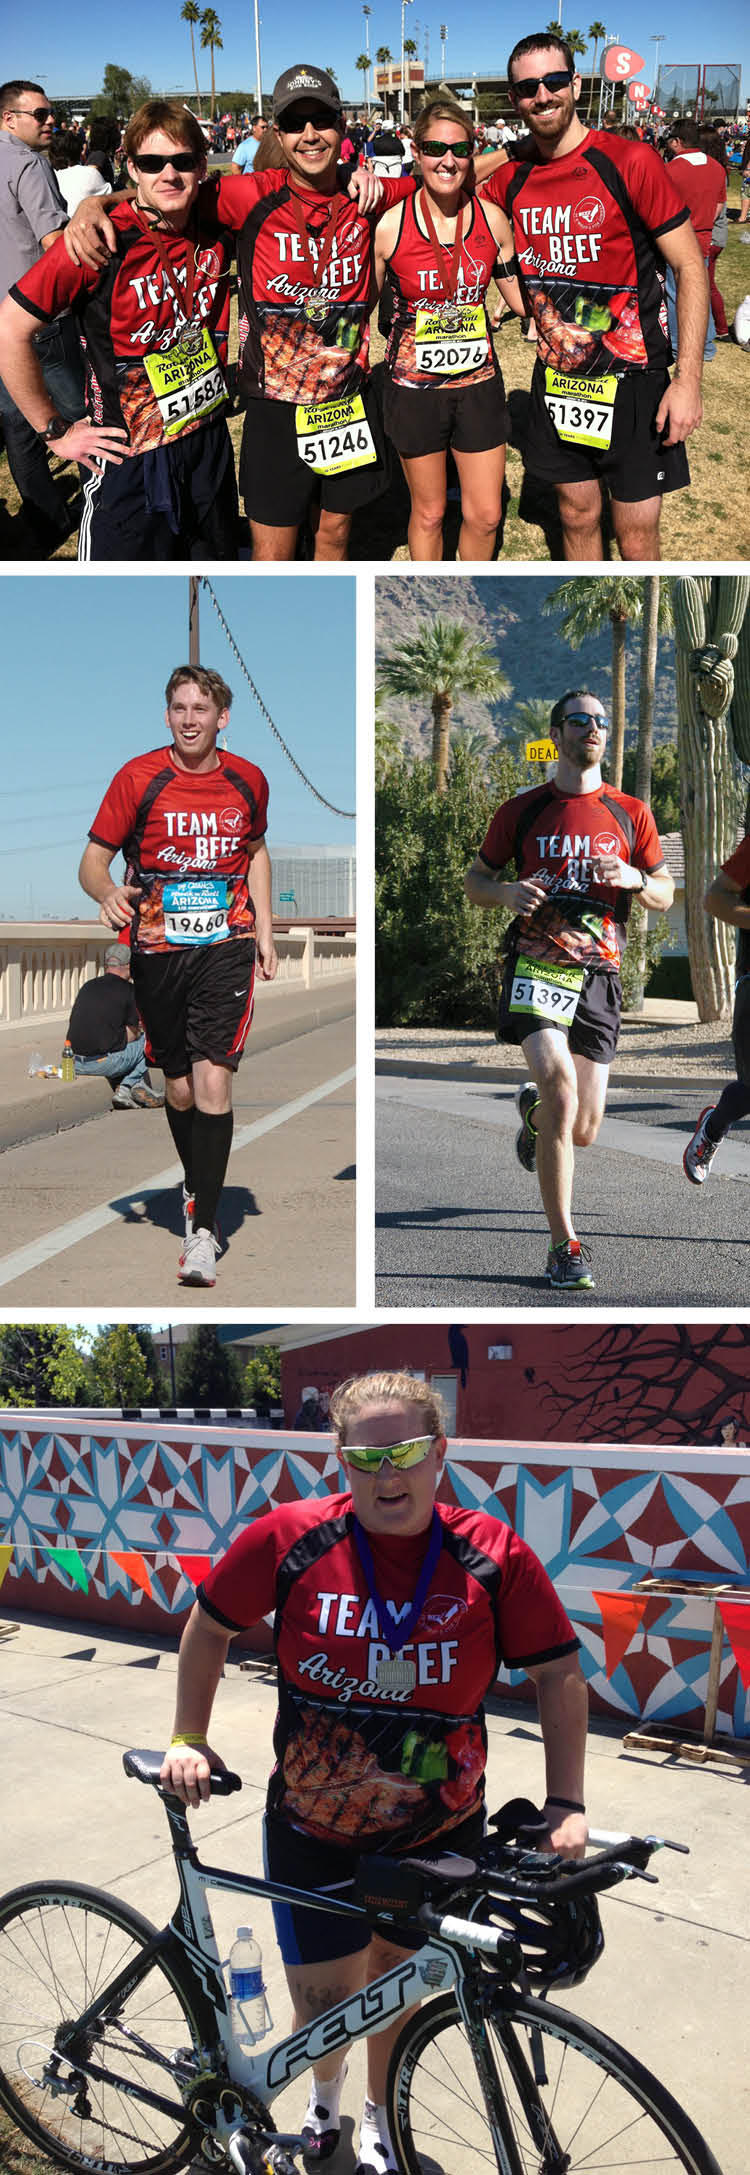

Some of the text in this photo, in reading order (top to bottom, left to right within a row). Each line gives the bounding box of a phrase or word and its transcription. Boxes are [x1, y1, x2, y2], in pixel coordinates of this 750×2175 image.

[616, 52, 631, 74] S
[634, 85, 645, 98] N
[520, 205, 571, 235] TEAM
[549, 234, 601, 264] BEEF
[518, 246, 577, 278] Arizona
[266, 273, 341, 305] Arizona
[421, 346, 483, 369] 52076
[167, 372, 224, 418] 51582
[552, 377, 604, 395] ARIZONA
[561, 390, 593, 400] marathon
[307, 405, 355, 426] ARIZONA
[318, 419, 347, 429] marathon
[548, 402, 609, 432] 51397
[304, 428, 368, 463] 51246
[163, 812, 218, 837] TEAM
[195, 836, 241, 860] BEEF
[535, 834, 591, 858] TEAM
[156, 845, 218, 873] Arizona
[531, 867, 590, 894] Arizona
[171, 895, 220, 906] ARIZONA
[168, 913, 225, 933] 19660
[514, 983, 575, 1012] 51397
[267, 1961, 417, 2088] FELT
